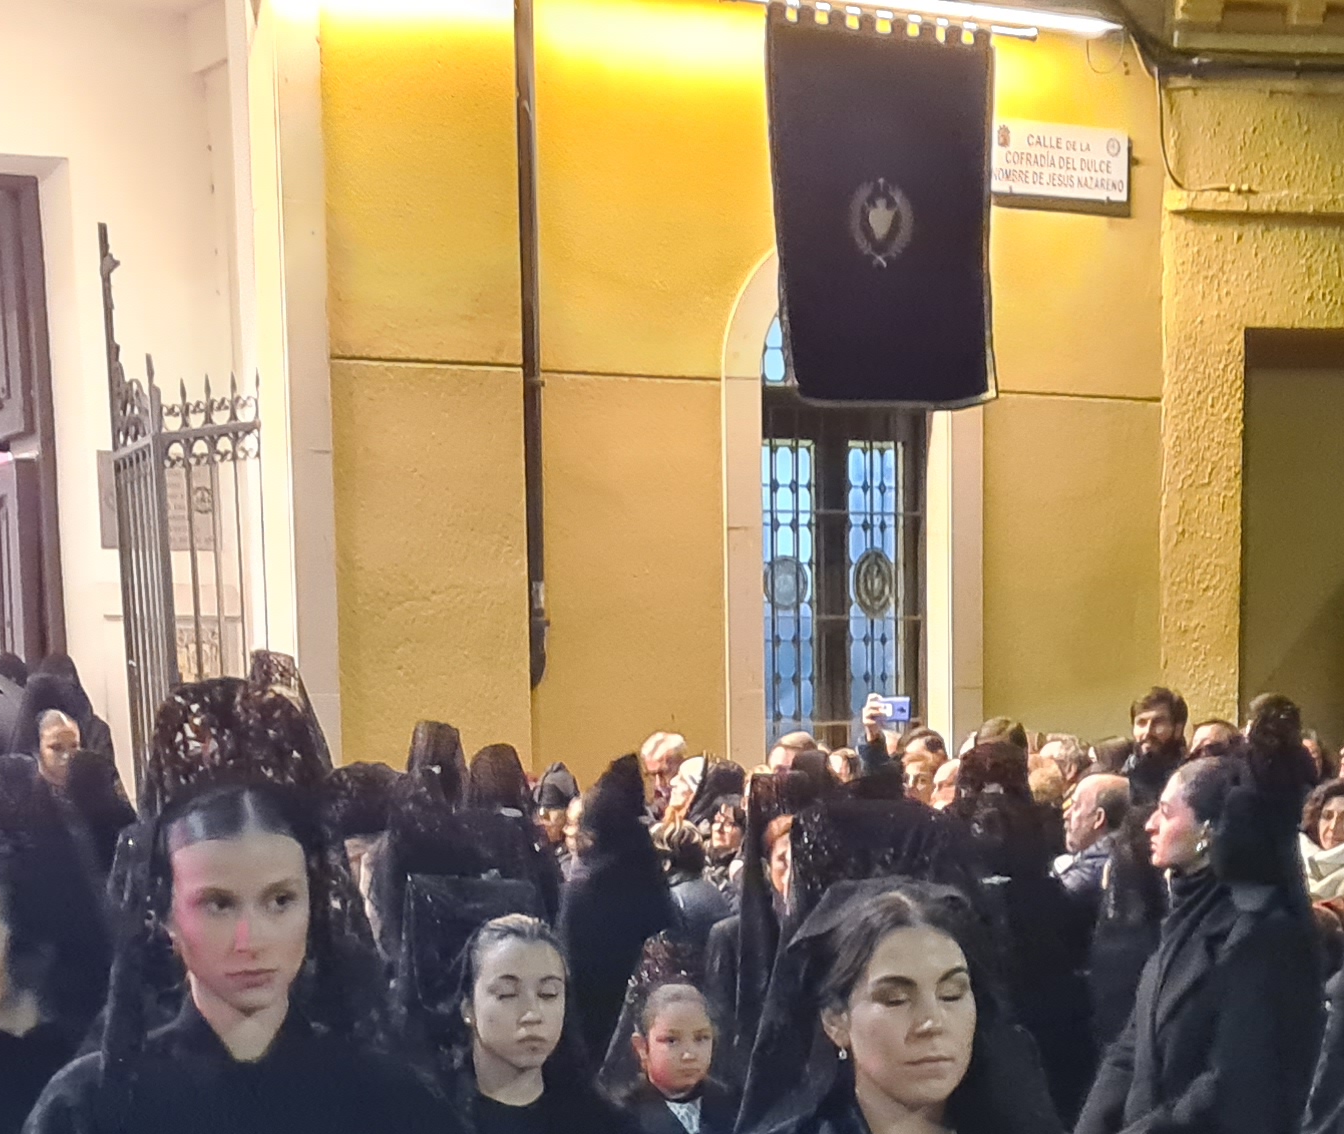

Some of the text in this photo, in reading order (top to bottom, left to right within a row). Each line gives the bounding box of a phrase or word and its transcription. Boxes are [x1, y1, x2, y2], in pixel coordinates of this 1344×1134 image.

[1027, 133, 1091, 152] CALLE DE LA
[1005, 150, 1112, 174] COFRADÍA DEL DULCE
[1032, 171, 1044, 186] DE
[1077, 176, 1124, 193] NAZARENO
